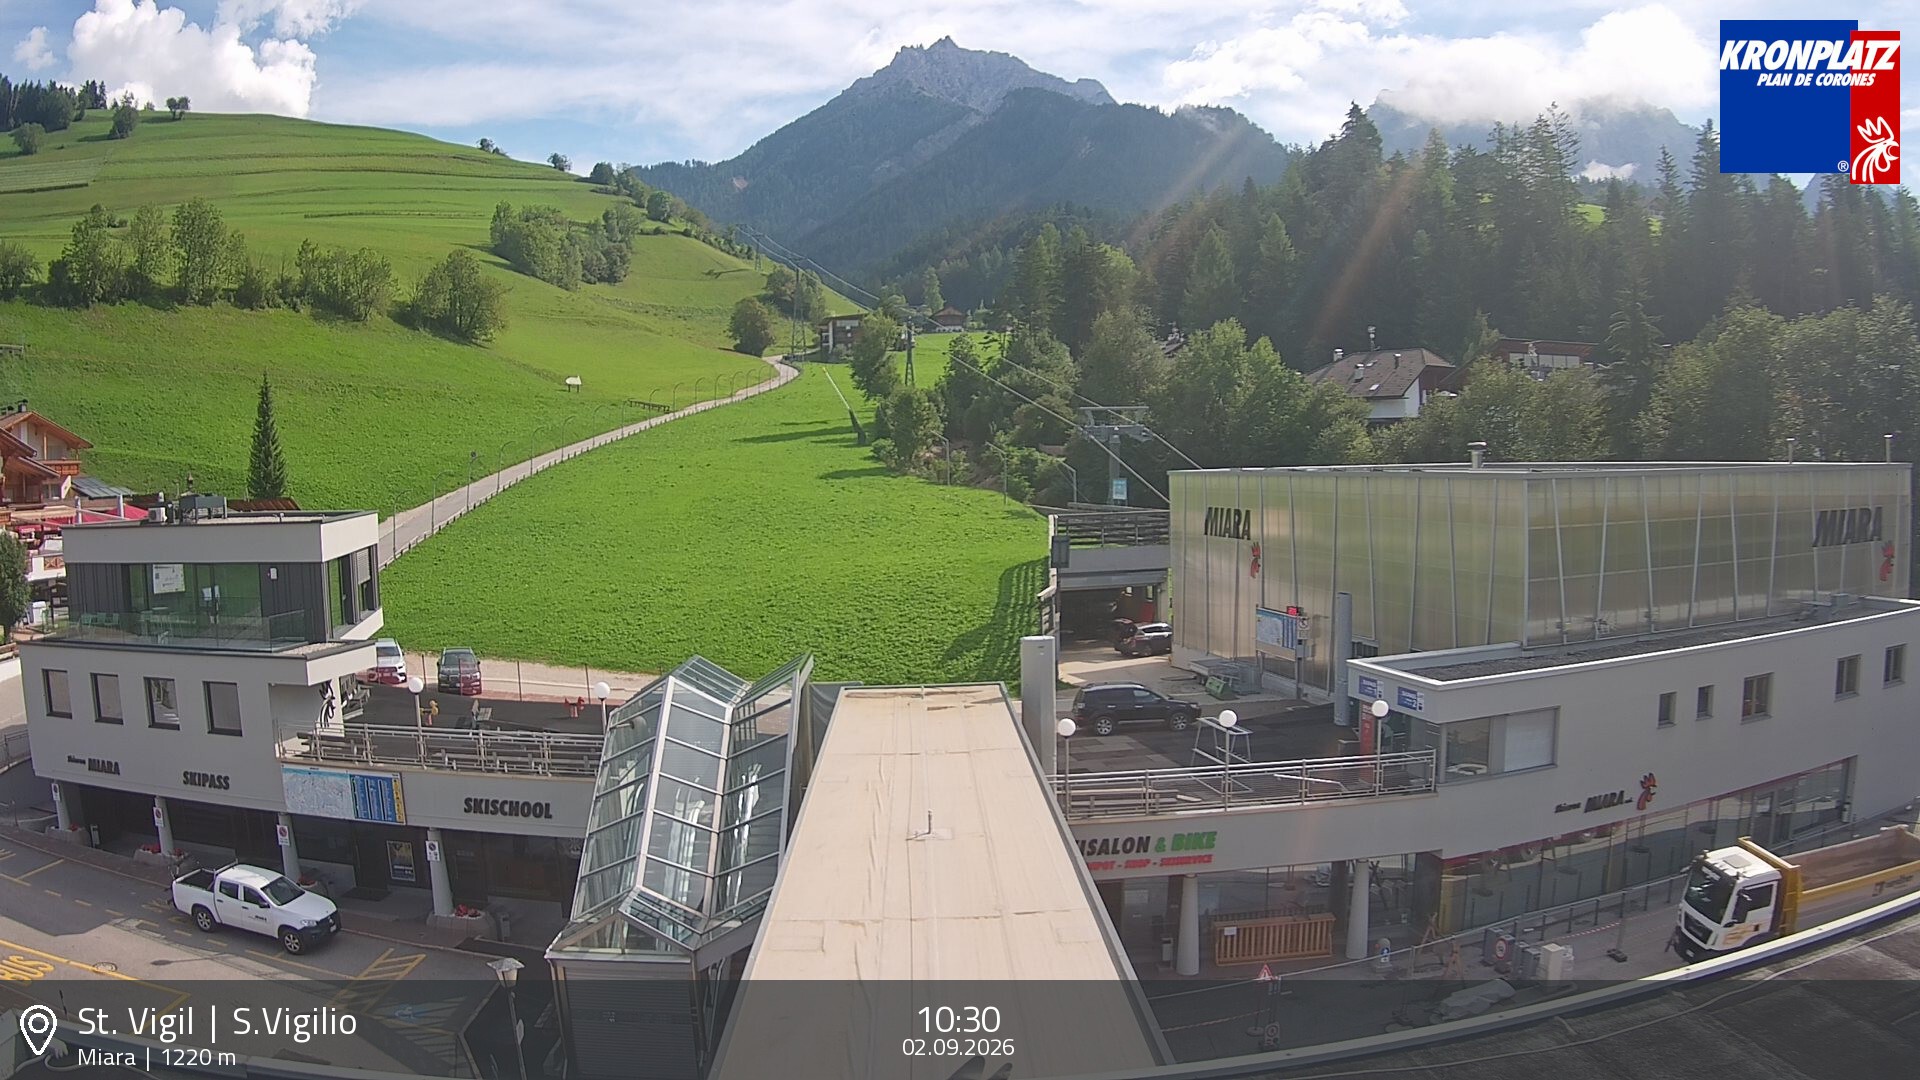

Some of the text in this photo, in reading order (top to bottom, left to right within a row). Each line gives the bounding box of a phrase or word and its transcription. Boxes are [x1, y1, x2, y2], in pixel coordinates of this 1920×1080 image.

[1204, 506, 1251, 540] MIARA
[1812, 507, 1883, 547] MIARA
[88, 758, 121, 775] MIARA
[183, 770, 230, 790] SKIPASS
[463, 797, 553, 819] SKISCHOOL
[1584, 790, 1625, 813] MIARA
[1076, 831, 1217, 856] ISALON & BIKE
